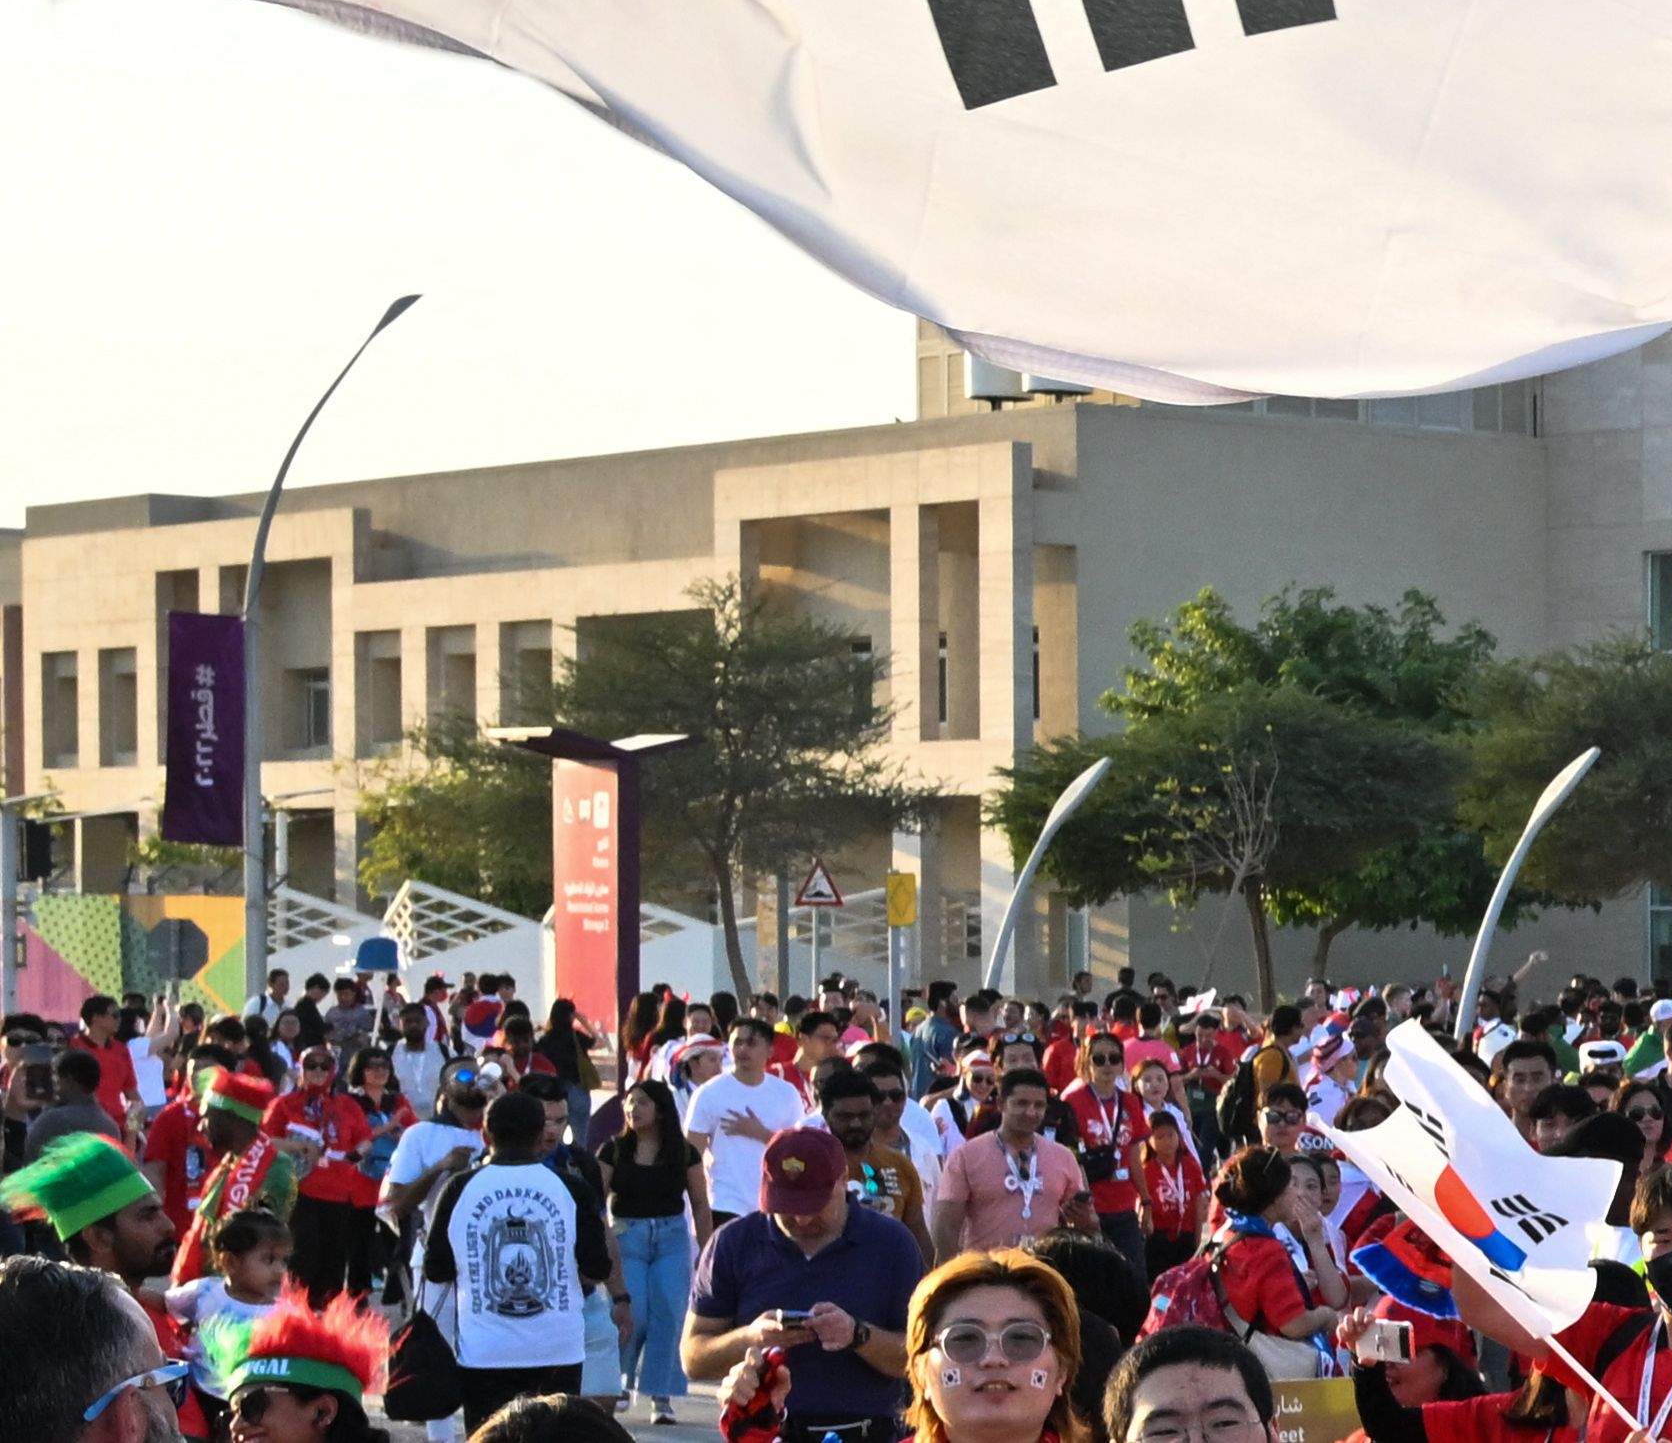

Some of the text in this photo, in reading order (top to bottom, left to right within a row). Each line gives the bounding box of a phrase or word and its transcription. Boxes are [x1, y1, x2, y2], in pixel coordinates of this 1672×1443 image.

[472, 1195, 493, 1221] AND
[495, 1187, 560, 1218] DARKNESS
[1274, 1395, 1303, 1418] شار
[1279, 1426, 1305, 1443] eet
